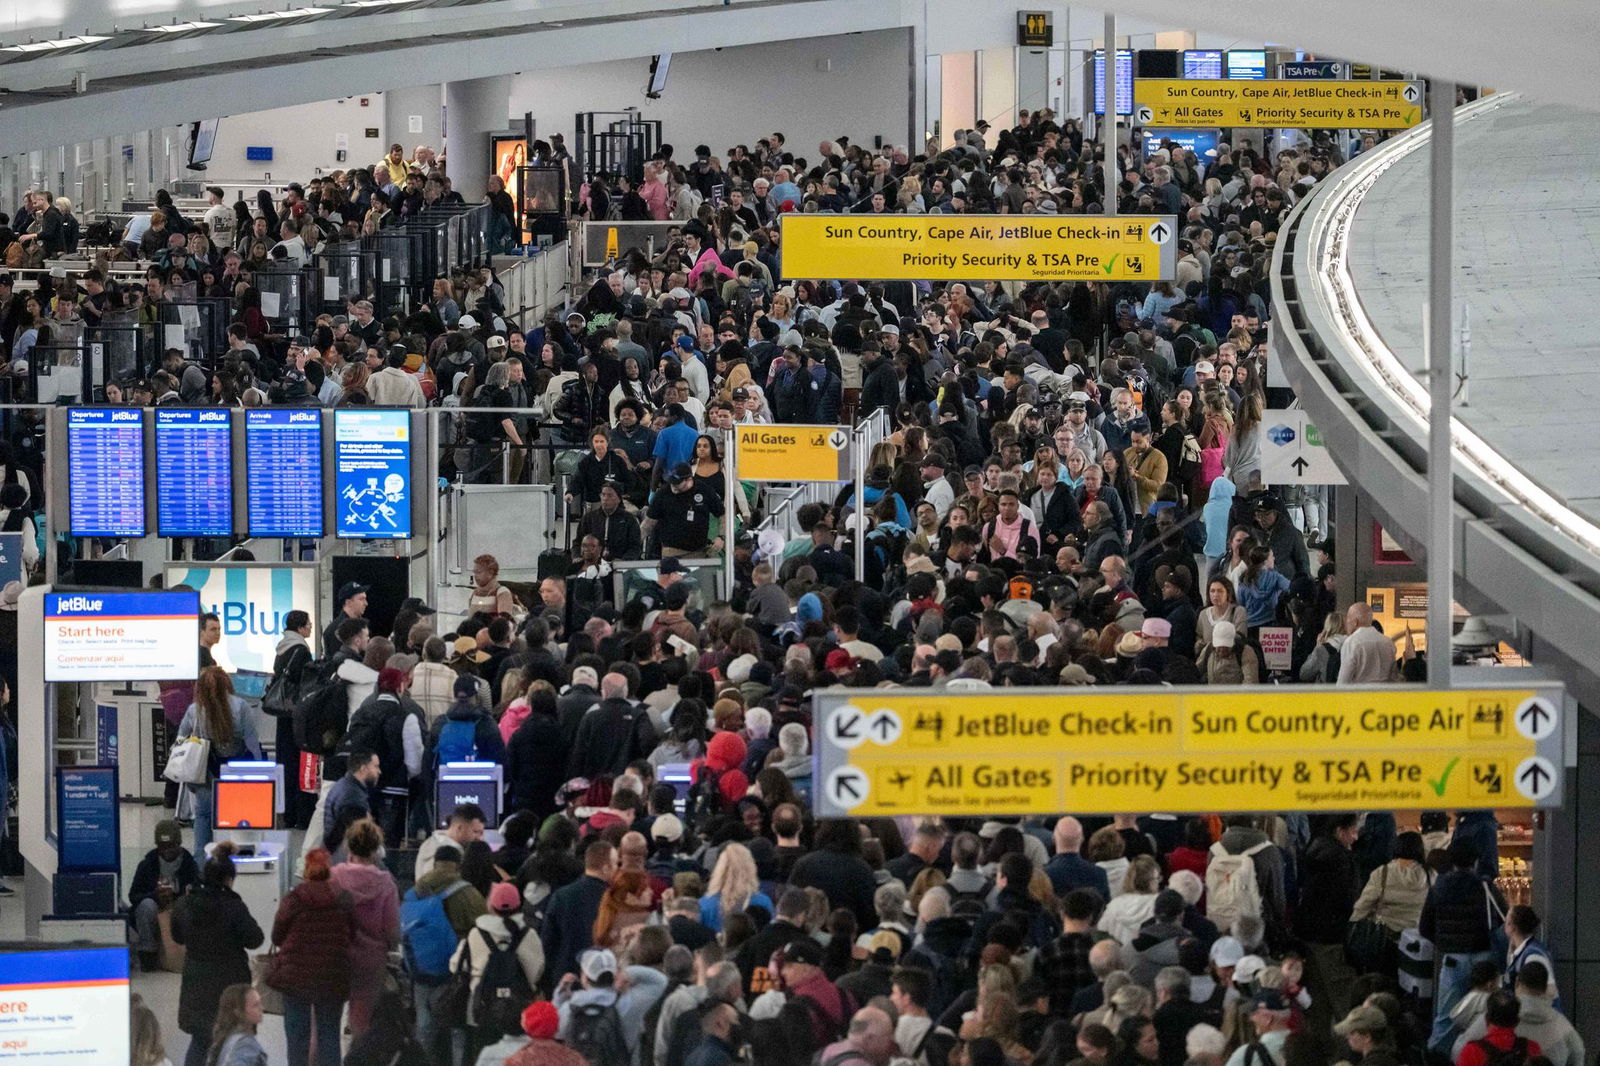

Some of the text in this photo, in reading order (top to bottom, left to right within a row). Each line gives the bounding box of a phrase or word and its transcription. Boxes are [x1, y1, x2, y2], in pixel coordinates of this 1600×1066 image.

[1287, 67, 1317, 76] TSA Pre
[1168, 87, 1381, 99] Sun Country, Cape Air, JetBlue Check-in
[1175, 107, 1223, 117] All Gates
[1256, 108, 1400, 120] Priority Security & TSA Pre
[826, 226, 1119, 242] Sun Country, Cape Air, JetBlue Check-in
[904, 253, 1099, 269] Priority Security & TSA Pre
[71, 411, 104, 419] Departures
[112, 411, 139, 422] jetBlue
[199, 412, 226, 422] jetBlue
[289, 412, 316, 423] jetBlue
[742, 433, 795, 444] All Gates
[57, 597, 103, 614] jetBlue
[58, 625, 125, 638] Start here
[57, 654, 102, 663] Comenzar
[954, 711, 1172, 737] JetBlue Check-in
[1192, 708, 1464, 739] Sun Country, Cape Air
[925, 765, 1052, 788] All Gates
[1071, 760, 1421, 792] Priority Security & TSA Pre
[64, 784, 101, 792] Remember,
[455, 795, 479, 805] Hello!
[1295, 789, 1422, 801] Seguridad Prioritaria
